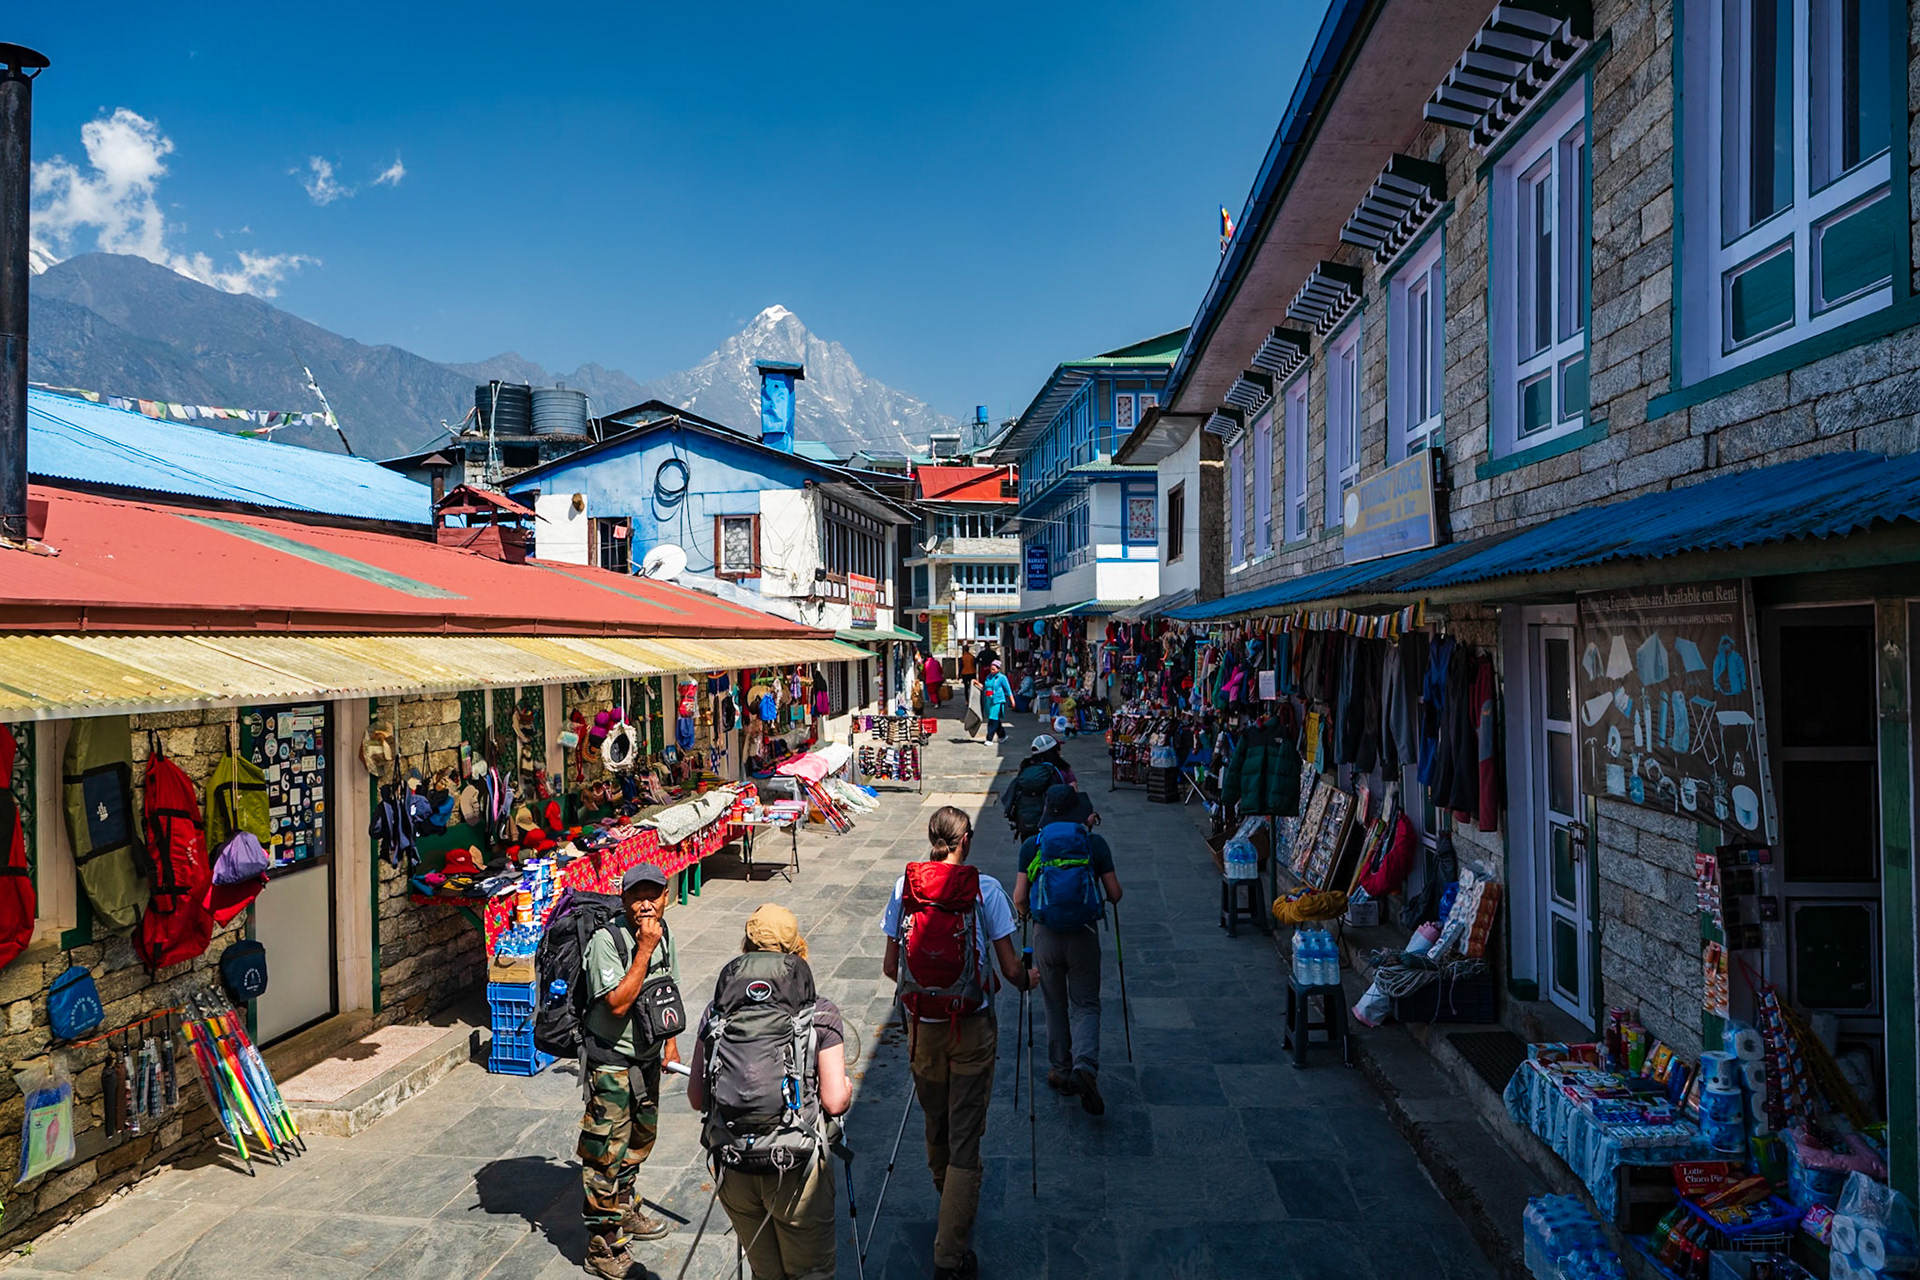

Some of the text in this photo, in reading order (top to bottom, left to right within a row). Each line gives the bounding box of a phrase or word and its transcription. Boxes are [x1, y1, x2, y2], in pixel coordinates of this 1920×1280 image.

[1651, 594, 1662, 606] are
[1664, 585, 1701, 606] Available
[1702, 590, 1715, 602] on
[1716, 585, 1738, 601] Rent
[71, 997, 86, 1027] Namaste
[86, 996, 99, 1014] Nepal
[1683, 1167, 1704, 1176] Lotte
[1685, 1174, 1723, 1184] Choco Pie
